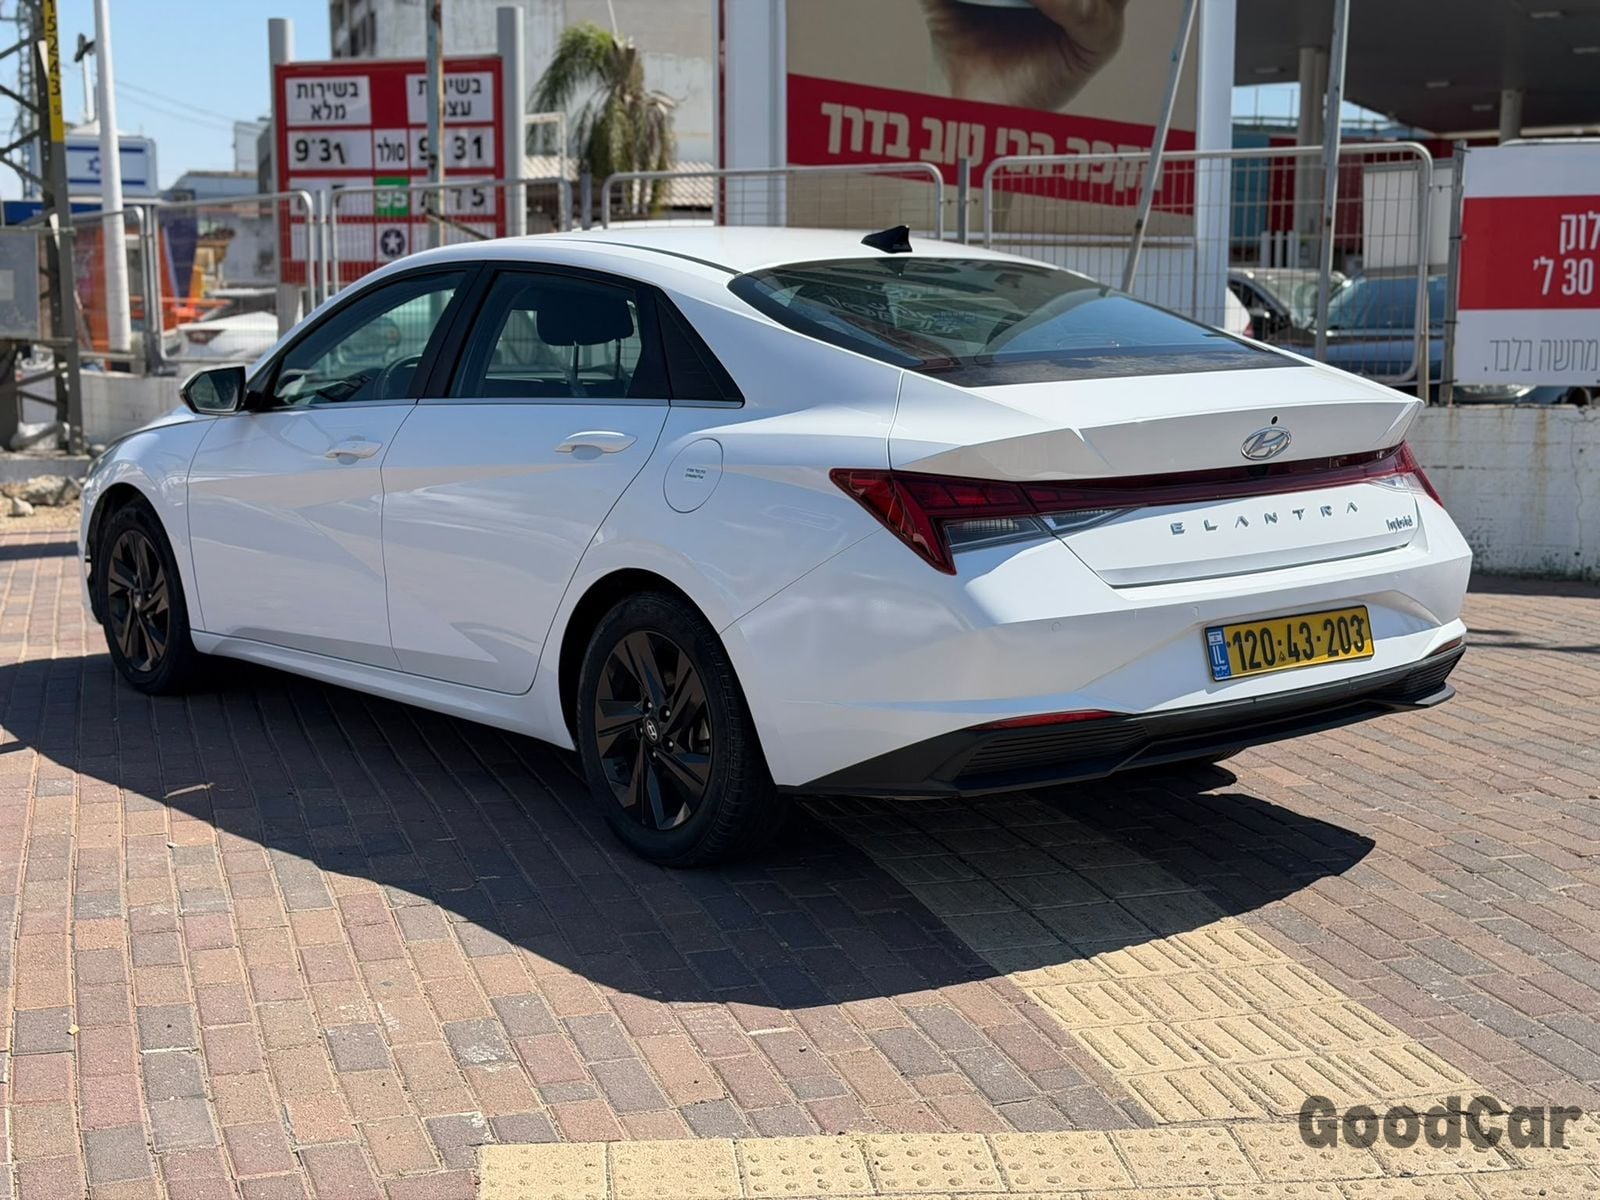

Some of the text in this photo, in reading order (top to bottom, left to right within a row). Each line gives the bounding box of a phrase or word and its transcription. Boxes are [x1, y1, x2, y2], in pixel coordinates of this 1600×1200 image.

[296, 82, 359, 99] בשירות
[418, 78, 481, 96] בשית
[311, 101, 346, 120] מלא
[441, 101, 471, 117] עצ
[821, 102, 911, 159] בדרך
[919, 116, 986, 168] טוב
[377, 137, 406, 162] סולר
[995, 126, 1056, 176] הכי
[1561, 258, 1594, 296] 30
[1538, 338, 1599, 372] מחשה
[1170, 501, 1359, 536] ELANTRA
[1212, 645, 1225, 665] IL
